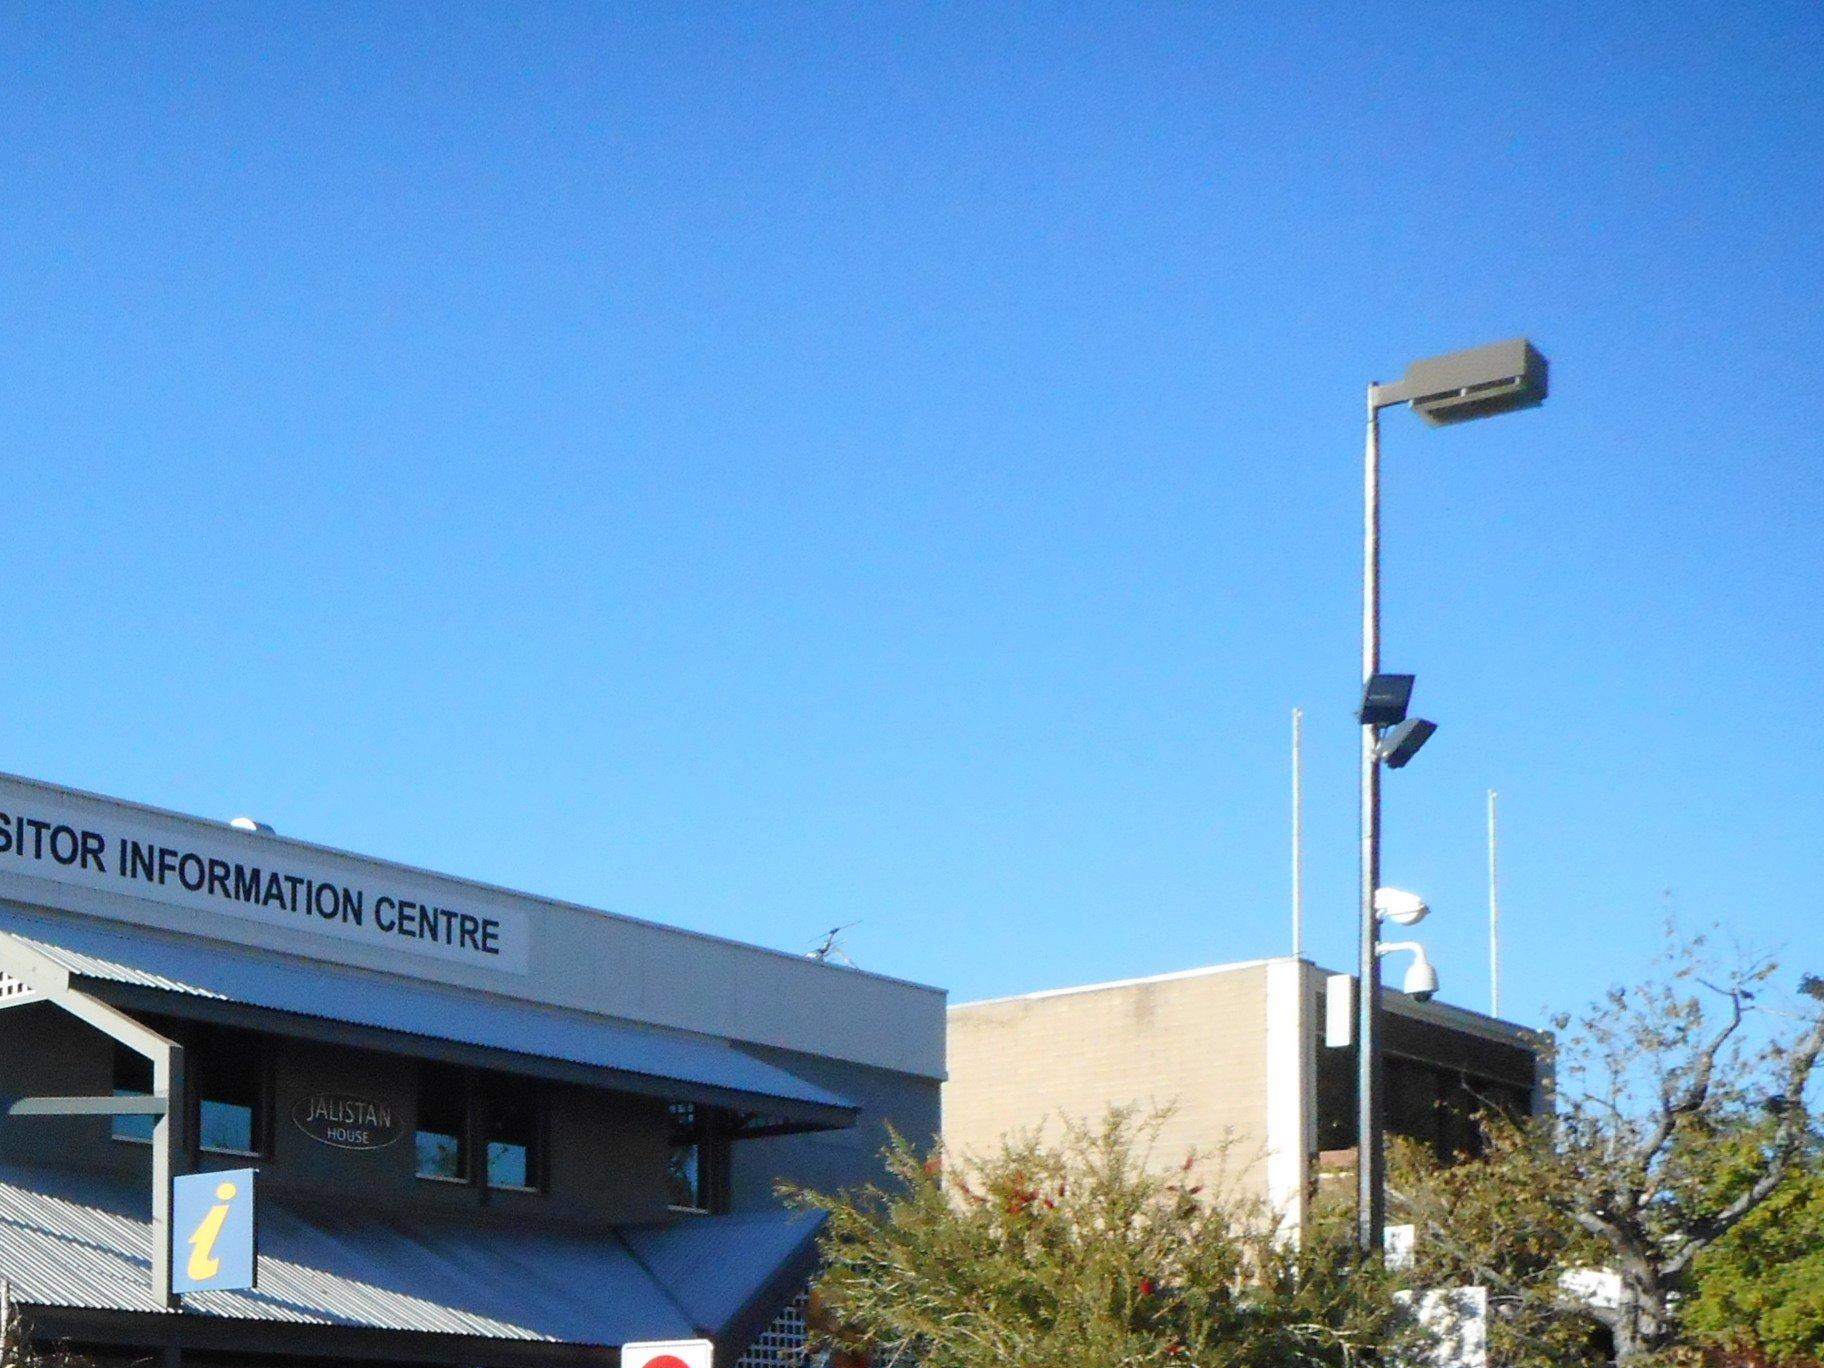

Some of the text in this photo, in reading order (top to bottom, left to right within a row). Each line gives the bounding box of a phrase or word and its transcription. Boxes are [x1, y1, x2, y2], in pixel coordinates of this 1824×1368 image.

[120, 838, 363, 926] INFORMATION
[375, 896, 500, 954] CENTRE
[306, 1098, 391, 1128] JALISTAN
[327, 1127, 370, 1144] HOUSE
